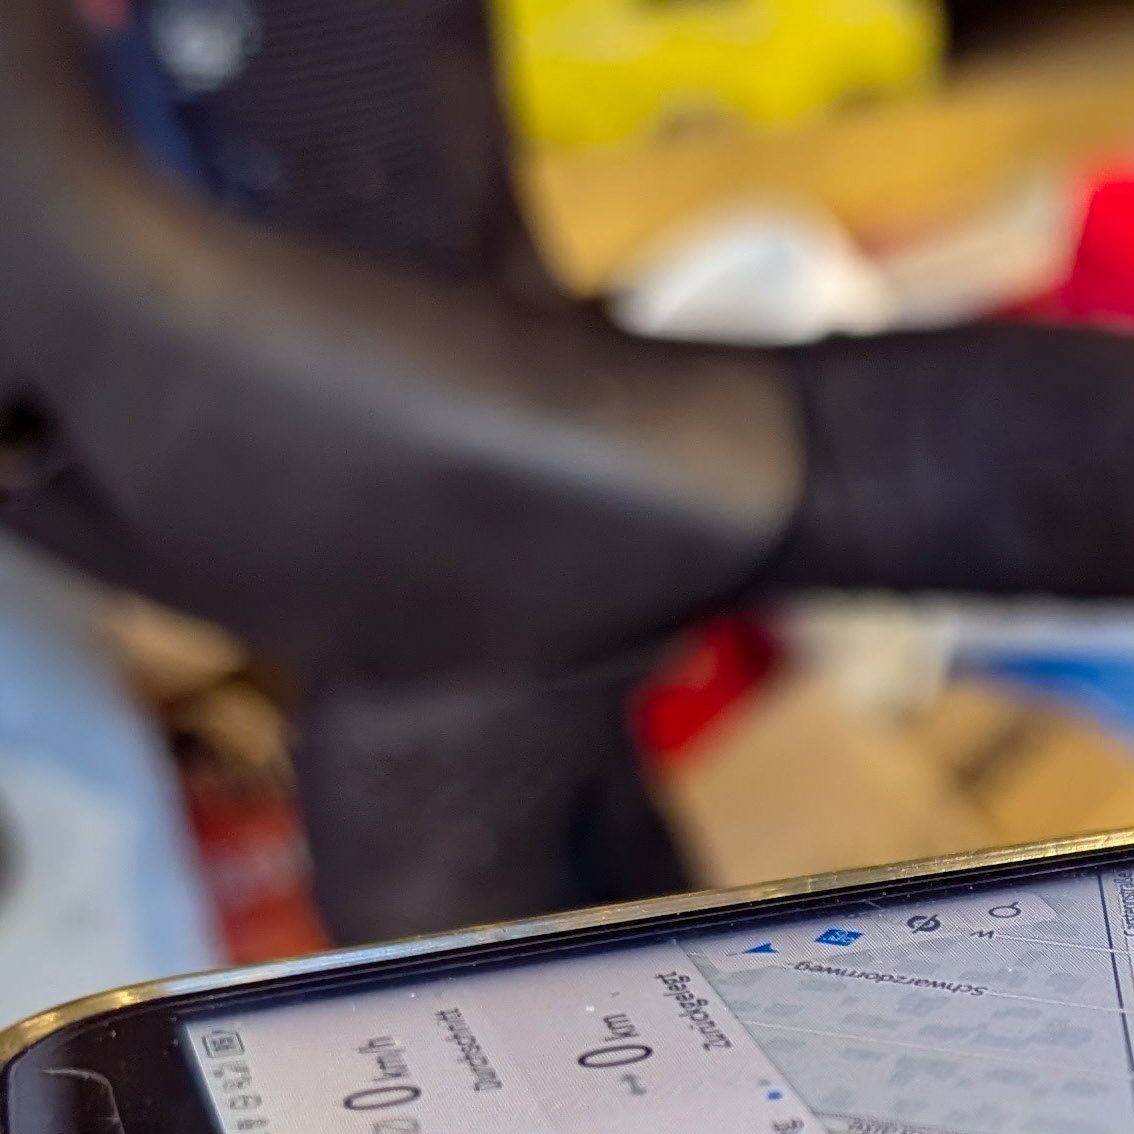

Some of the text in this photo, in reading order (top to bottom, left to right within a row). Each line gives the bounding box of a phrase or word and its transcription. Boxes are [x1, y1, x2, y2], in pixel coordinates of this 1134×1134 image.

[654, 971, 733, 1051] Zurückgelegt
[794, 960, 988, 996] Schwarzdornweg
[343, 1035, 422, 1111] 0 km/h
[434, 1007, 504, 1092] Durchschnitt
[577, 1013, 653, 1068] 0 km
